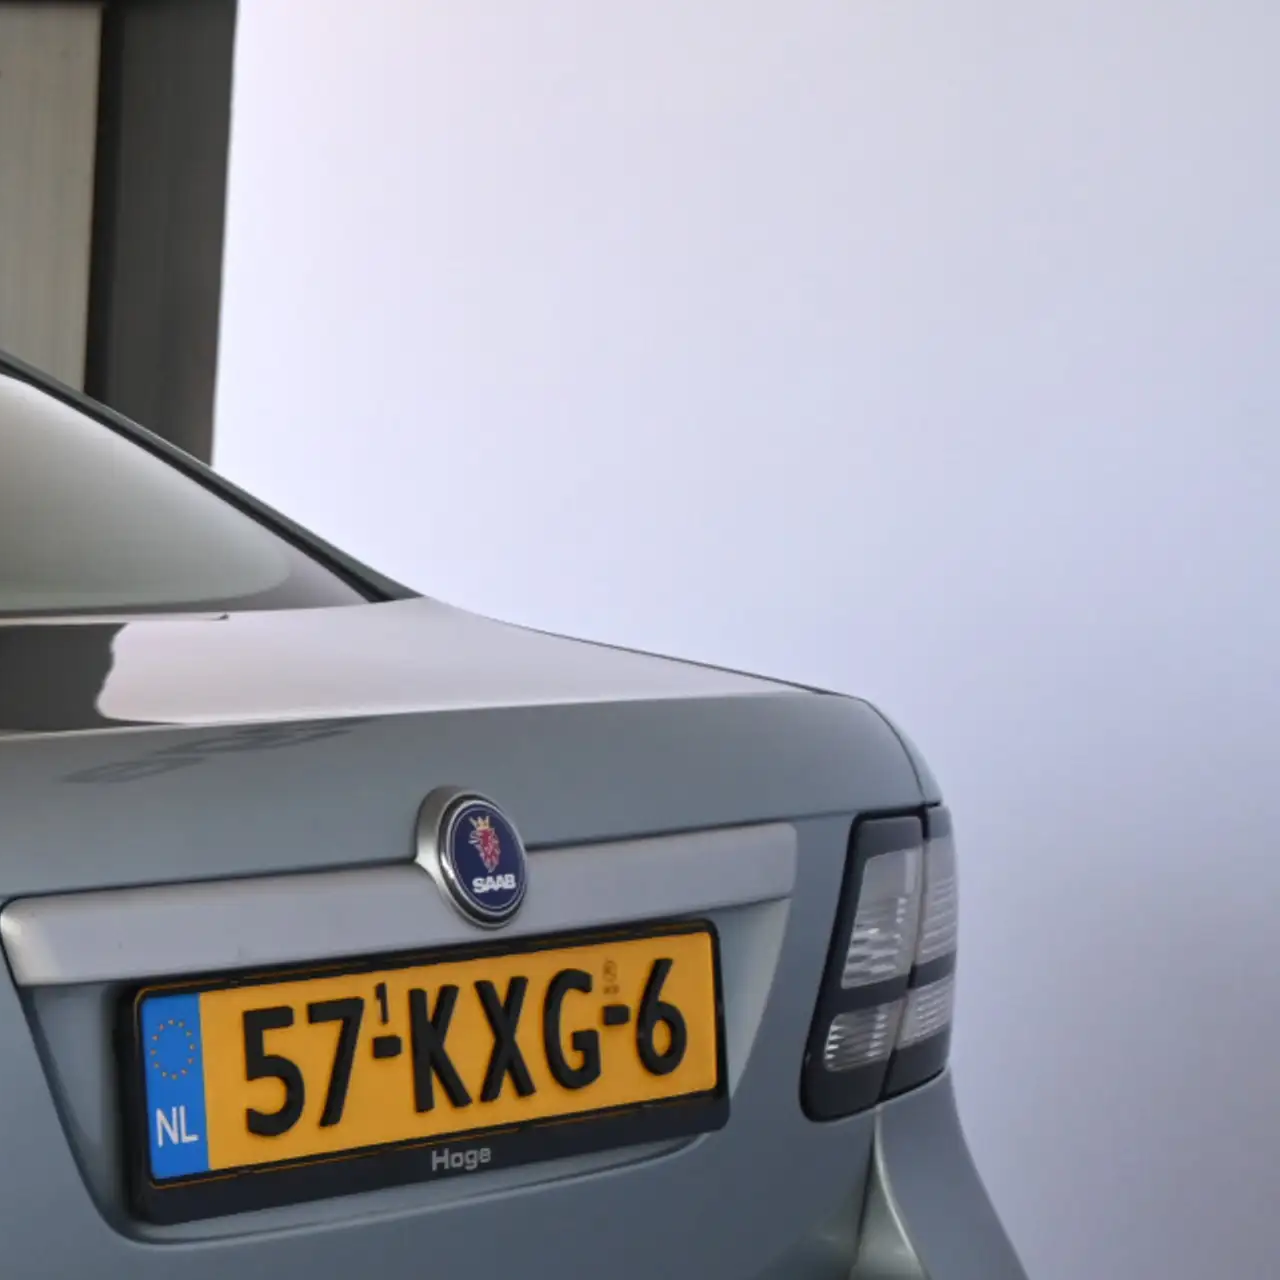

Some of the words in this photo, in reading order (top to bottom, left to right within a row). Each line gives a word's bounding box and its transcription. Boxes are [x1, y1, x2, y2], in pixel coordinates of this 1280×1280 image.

[472, 874, 517, 893] SAAB
[243, 957, 688, 1138] 57-KXG-6
[155, 1105, 199, 1148] NL
